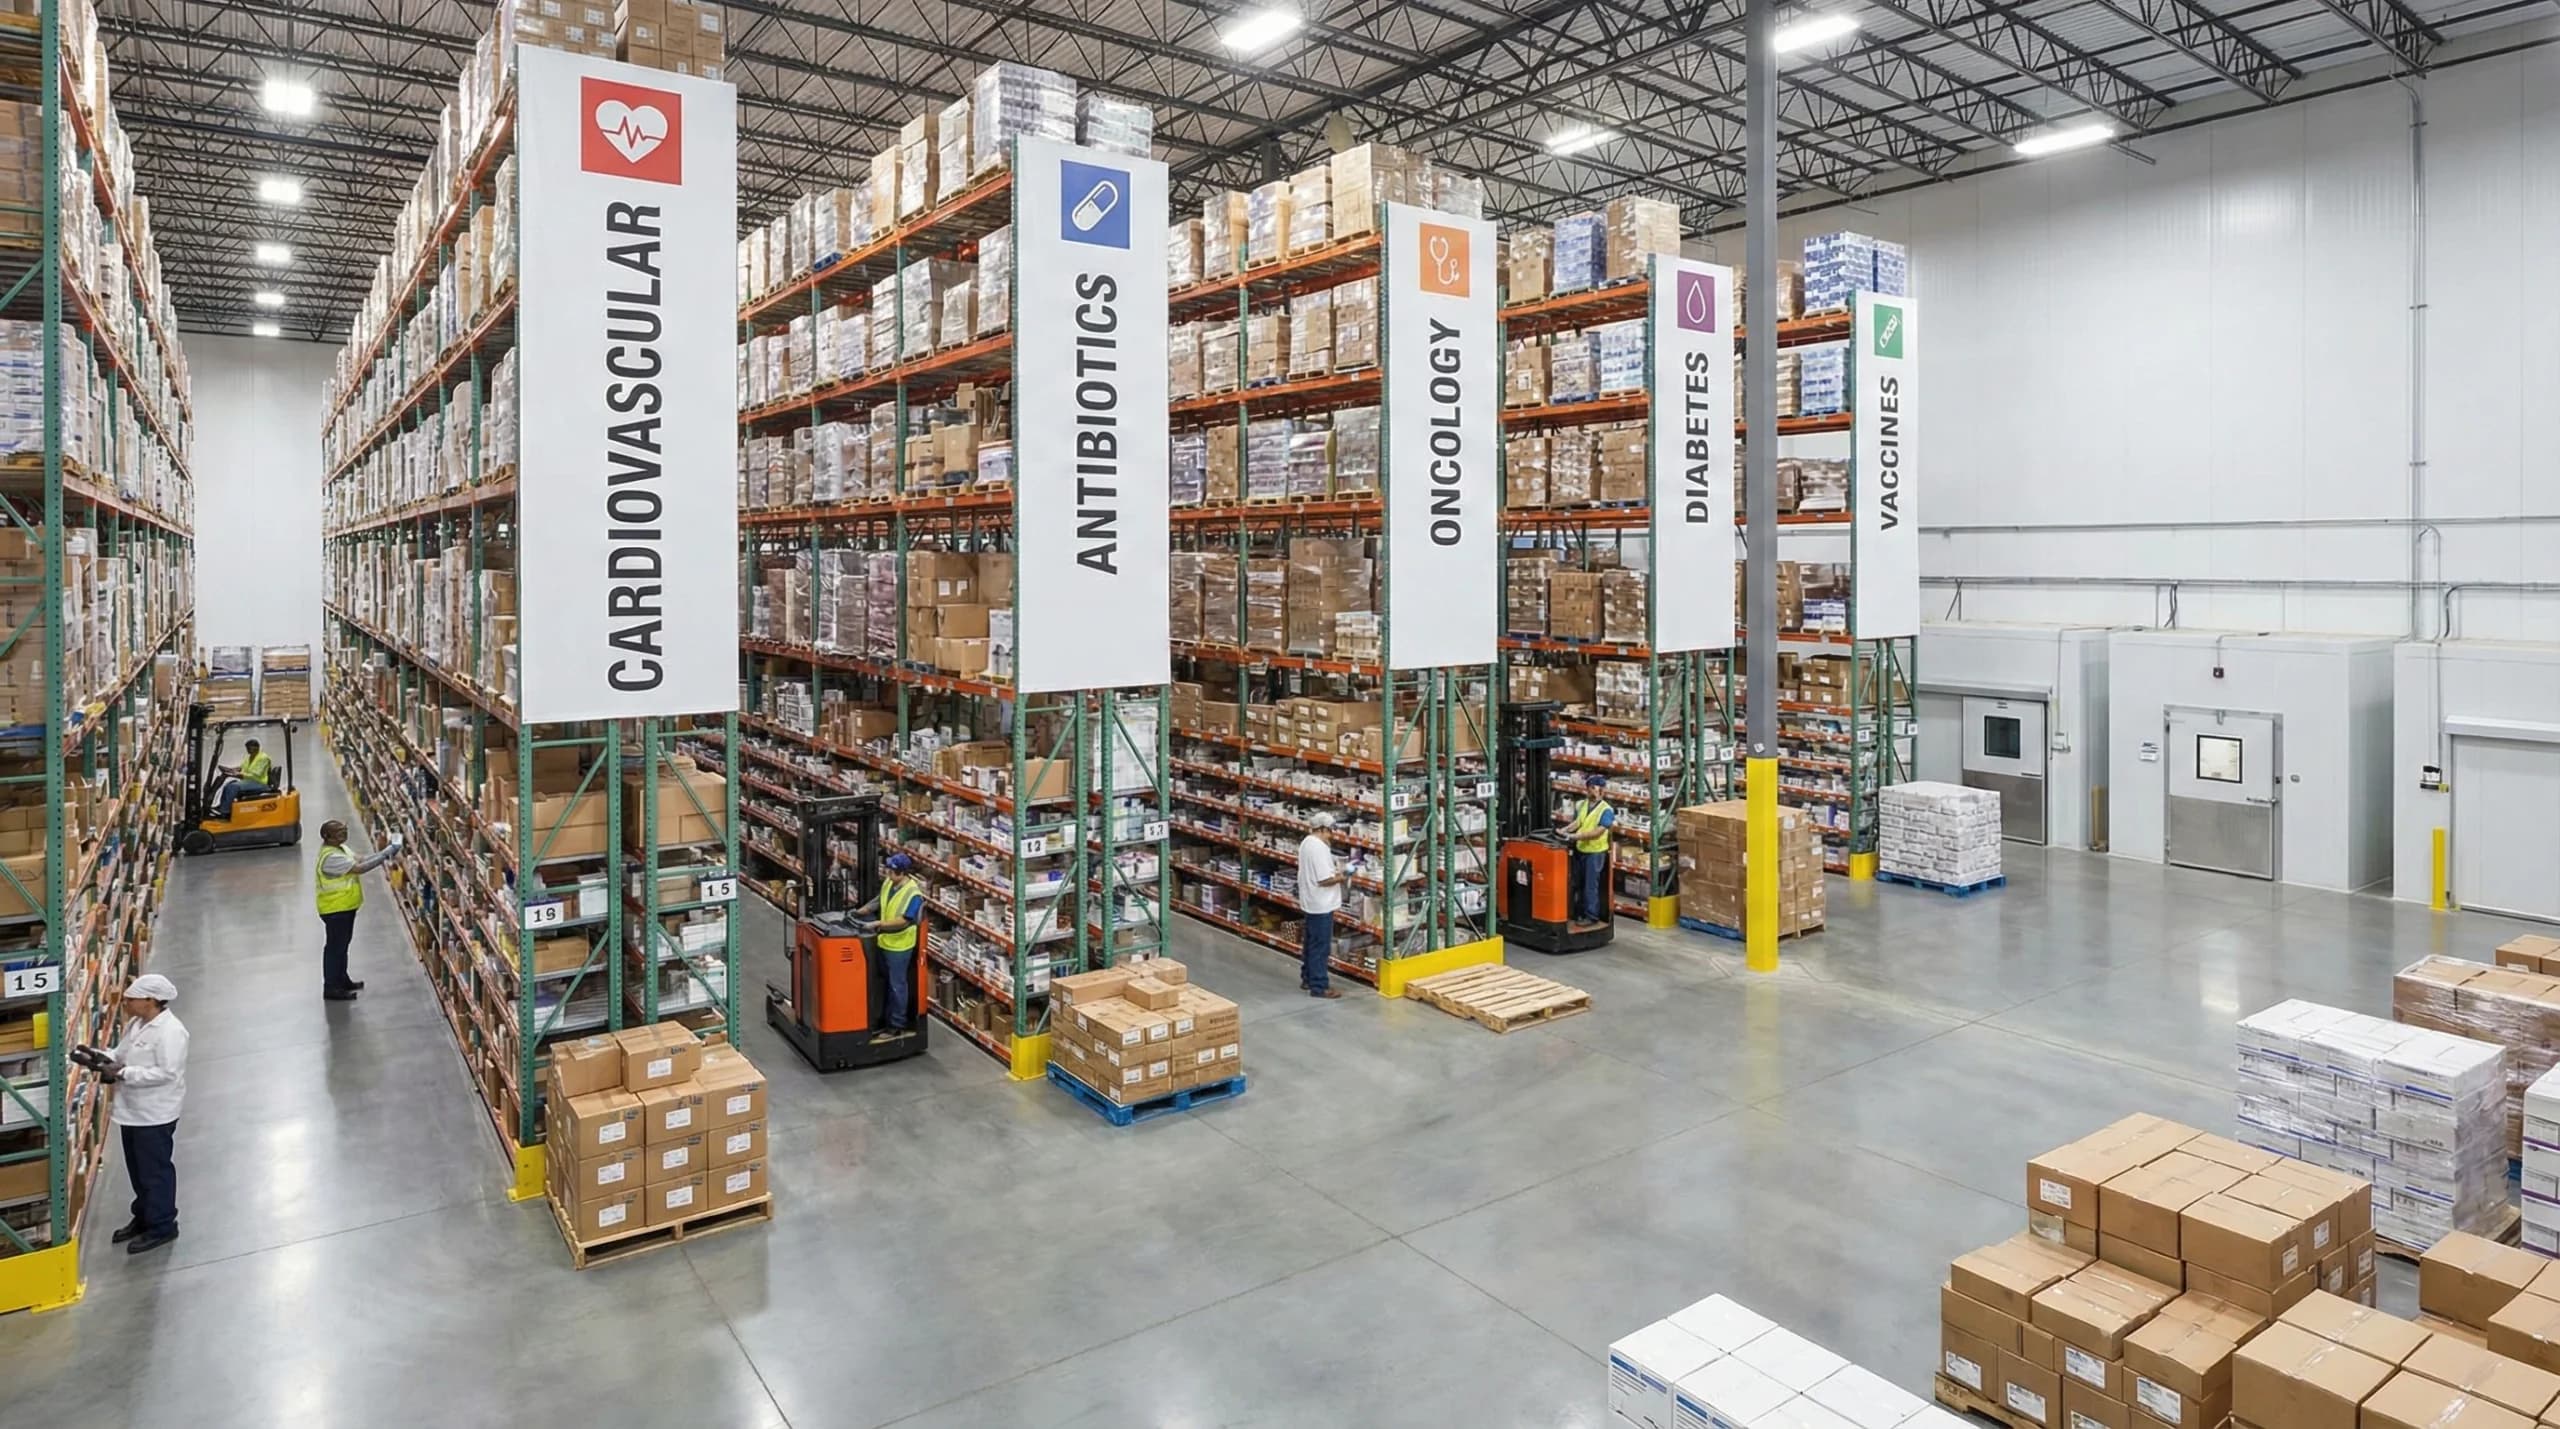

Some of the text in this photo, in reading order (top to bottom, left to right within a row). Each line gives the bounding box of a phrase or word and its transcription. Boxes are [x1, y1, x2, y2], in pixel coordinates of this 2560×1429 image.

[606, 201, 663, 693] CARDIOVASCULAR
[1075, 273, 1118, 576] ANTIBIOTICS
[1429, 317, 1462, 547] ONCOLOGY
[1685, 351, 1709, 524] DIABETES
[1879, 375, 1899, 531] VACCINES
[14, 972, 48, 991] 15
